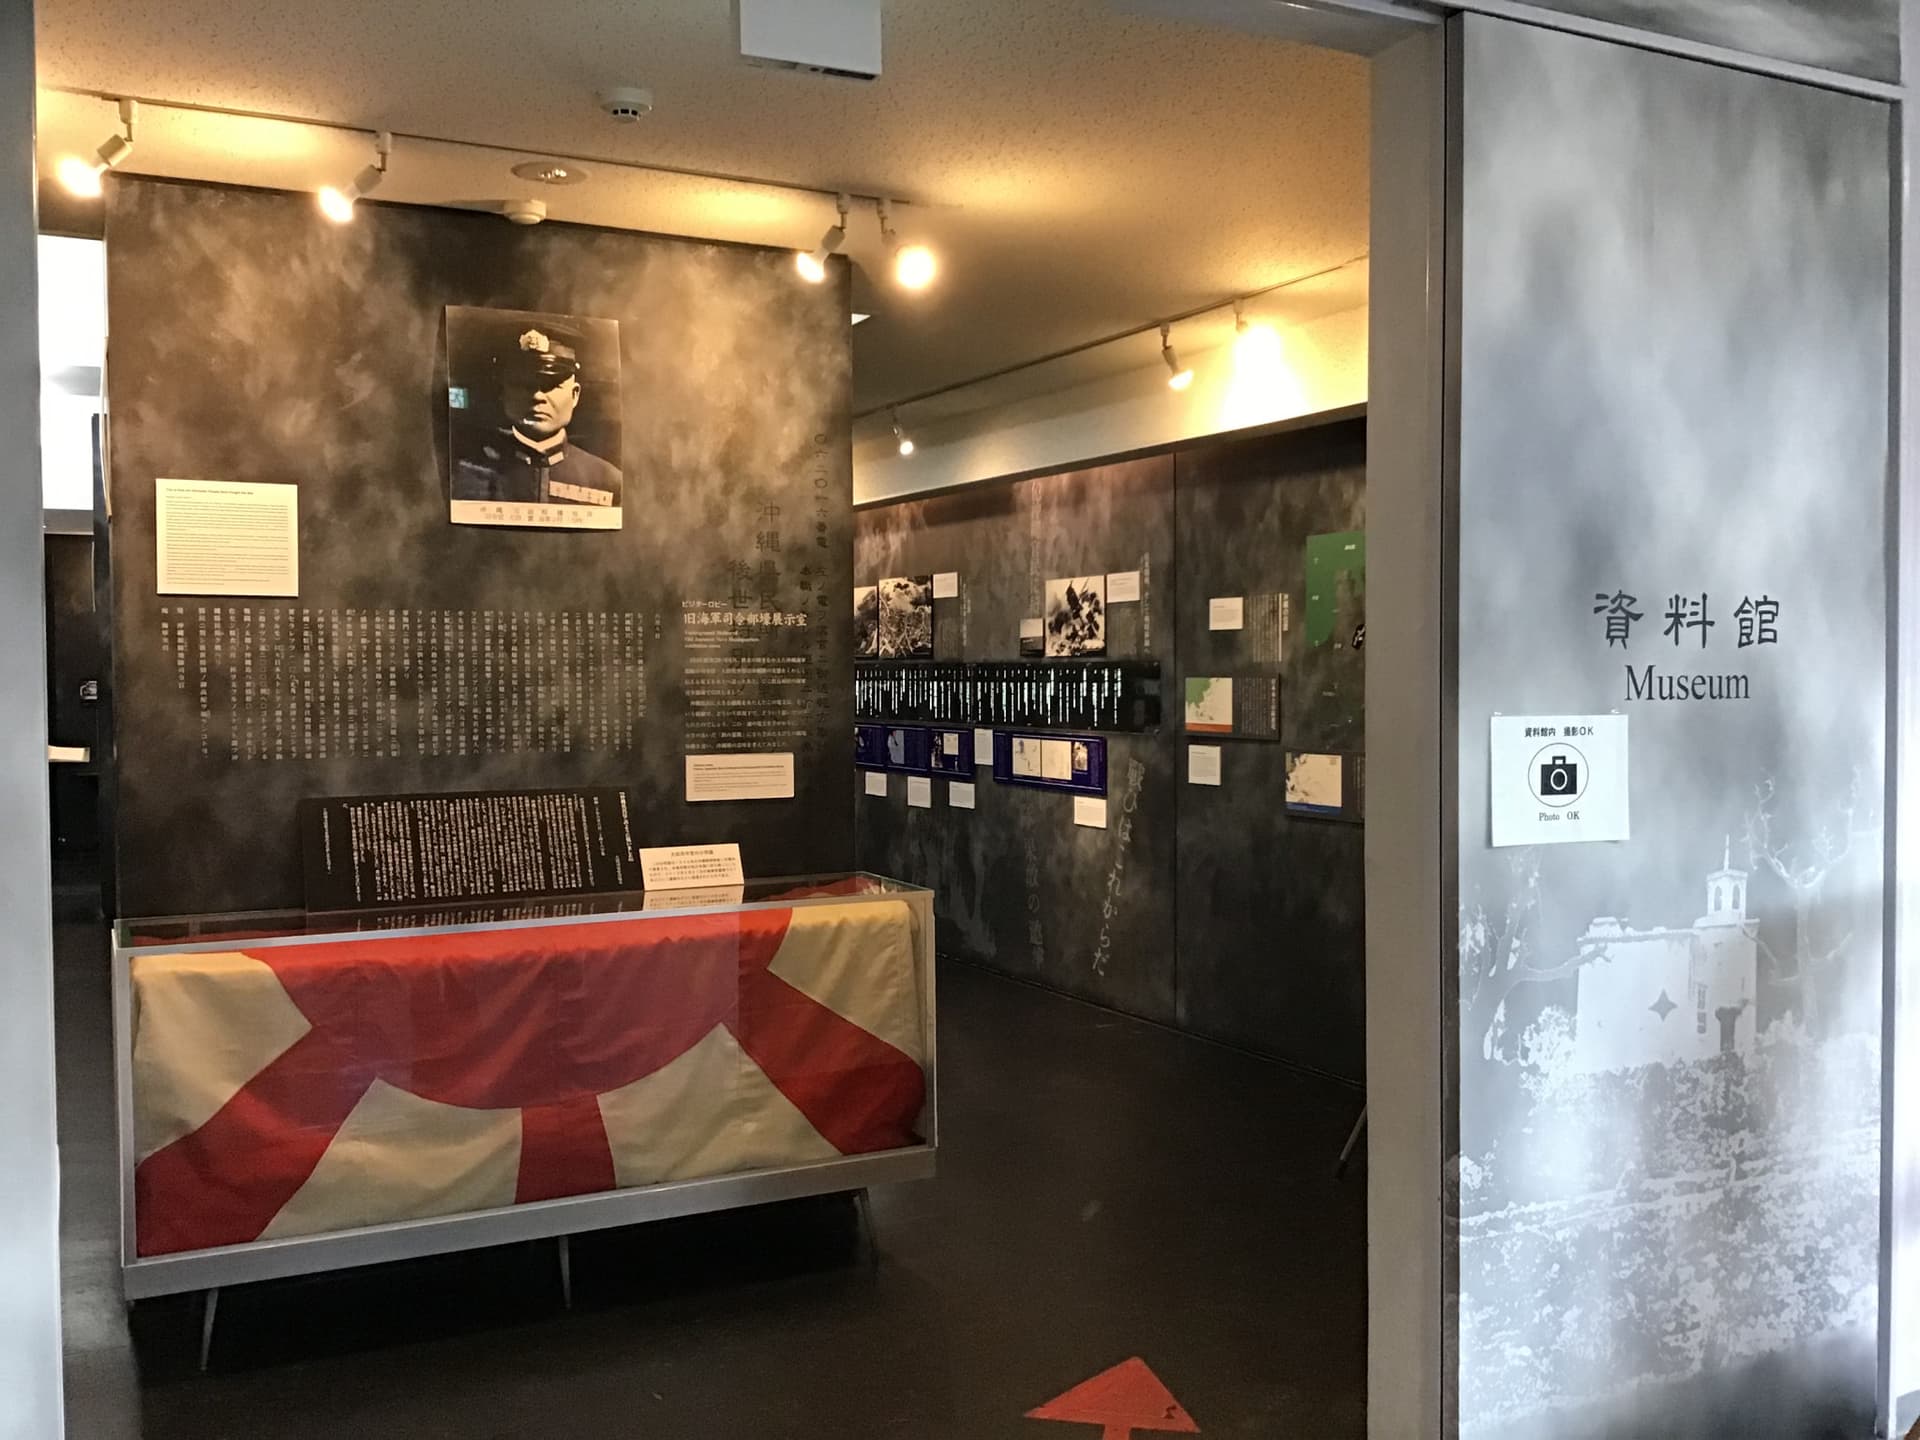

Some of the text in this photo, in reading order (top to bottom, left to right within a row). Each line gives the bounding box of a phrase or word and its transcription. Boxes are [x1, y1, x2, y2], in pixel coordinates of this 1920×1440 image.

[1593, 589, 1779, 650] 資料館
[1624, 664, 1750, 701] Museum
[1524, 727, 1556, 738] 資料館内
[1538, 810, 1580, 821] Photo OK
